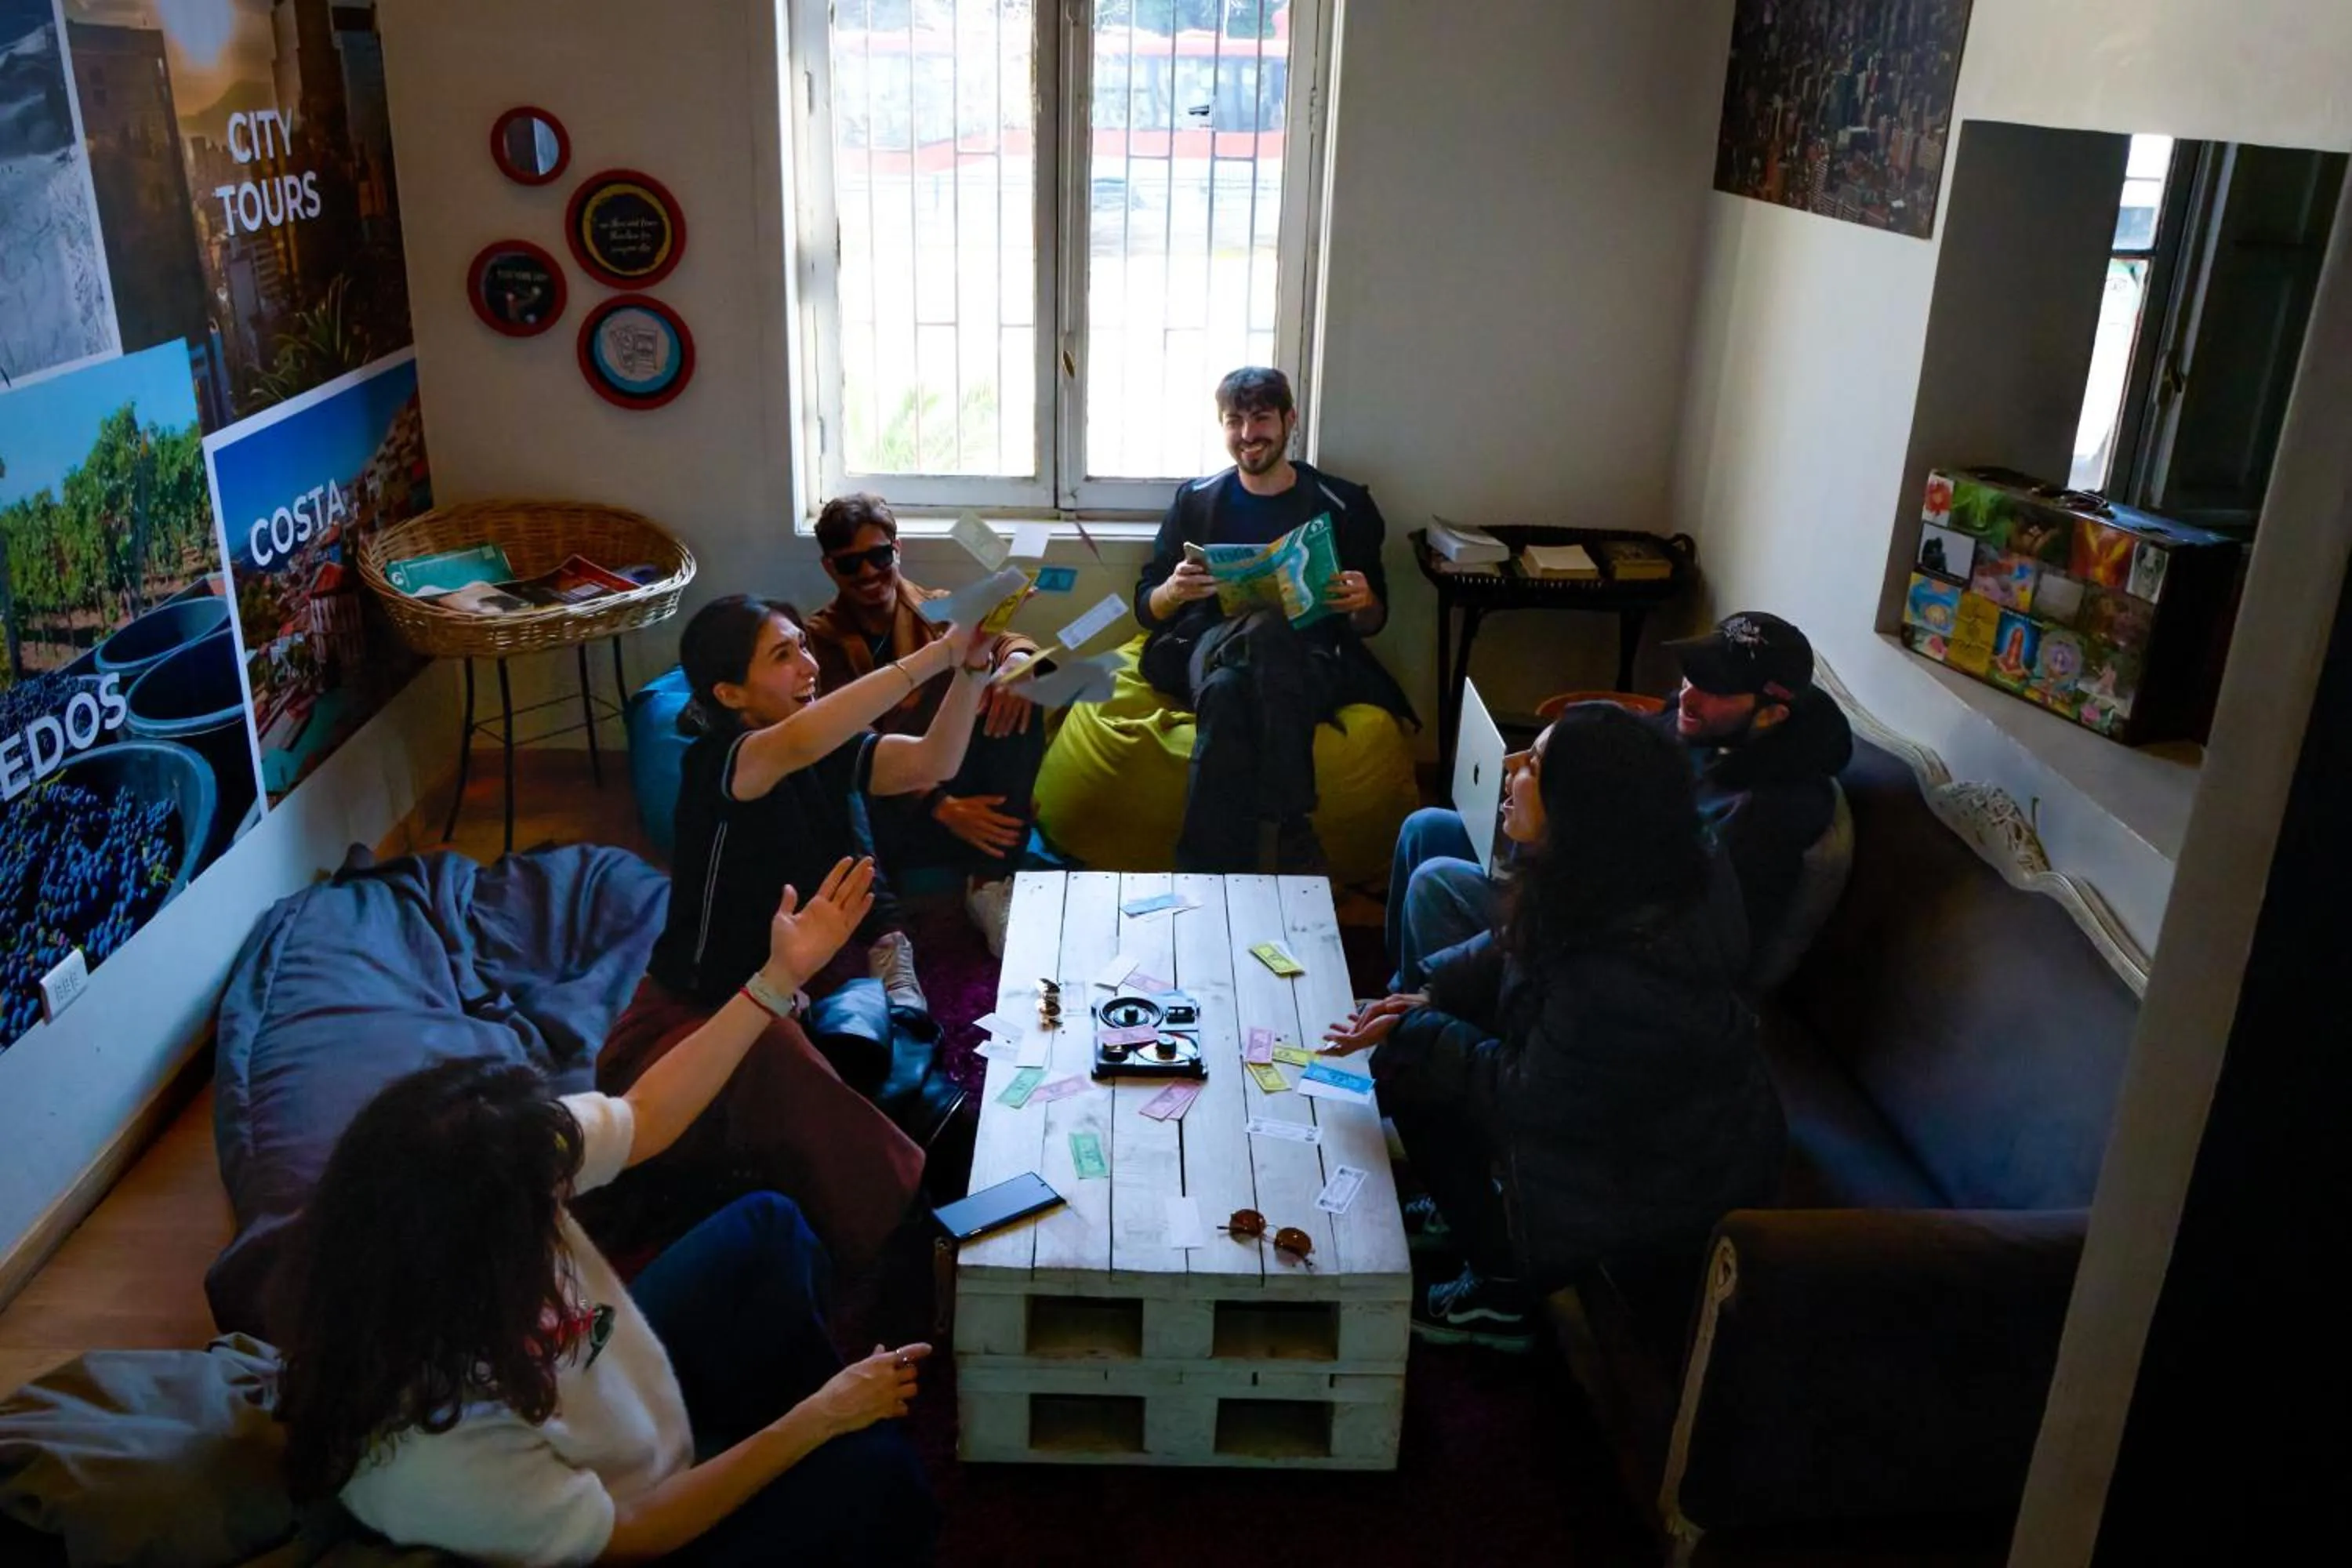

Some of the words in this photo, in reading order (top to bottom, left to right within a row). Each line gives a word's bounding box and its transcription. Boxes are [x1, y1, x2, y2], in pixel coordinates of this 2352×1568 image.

[228, 108, 292, 163] CITY
[214, 171, 321, 236] TOURS
[251, 477, 346, 566] COSTA
[0, 672, 126, 802] EDOS
